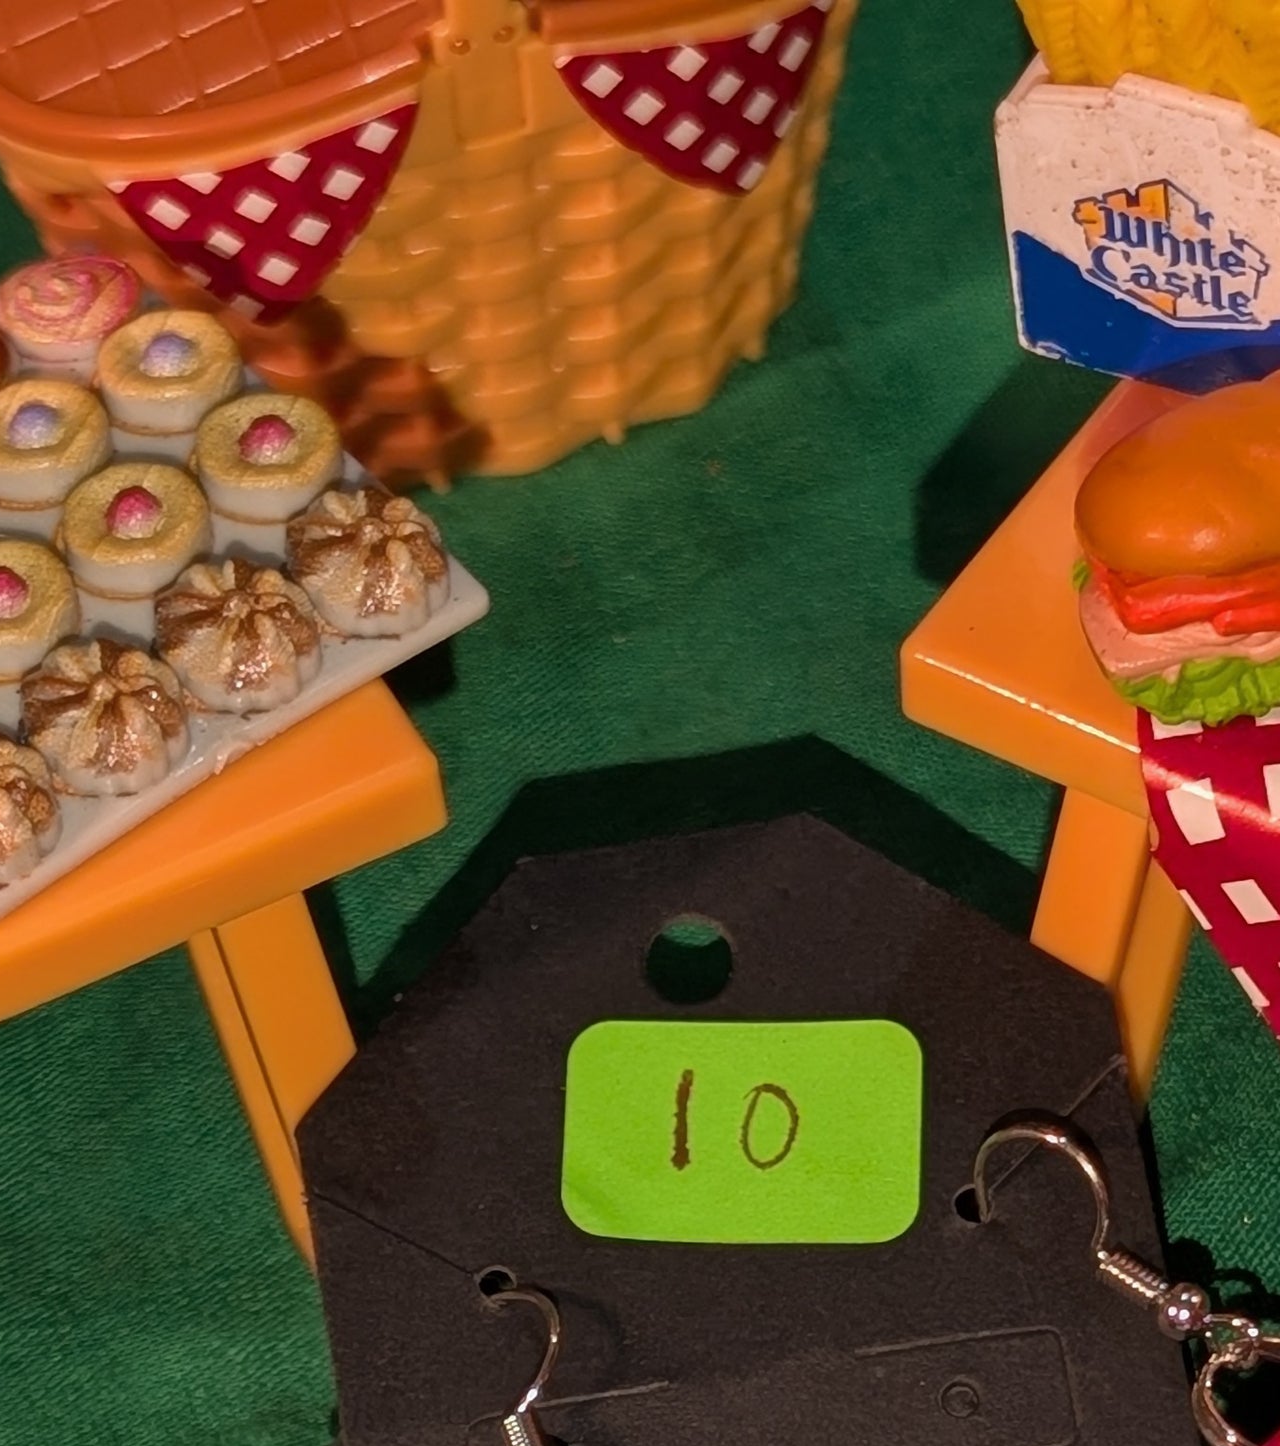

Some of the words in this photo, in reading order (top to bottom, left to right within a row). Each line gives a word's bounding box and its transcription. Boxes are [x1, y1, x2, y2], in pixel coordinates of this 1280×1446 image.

[1097, 204, 1248, 277] White
[1090, 245, 1255, 318] Castle
[669, 1067, 800, 1172] 10
